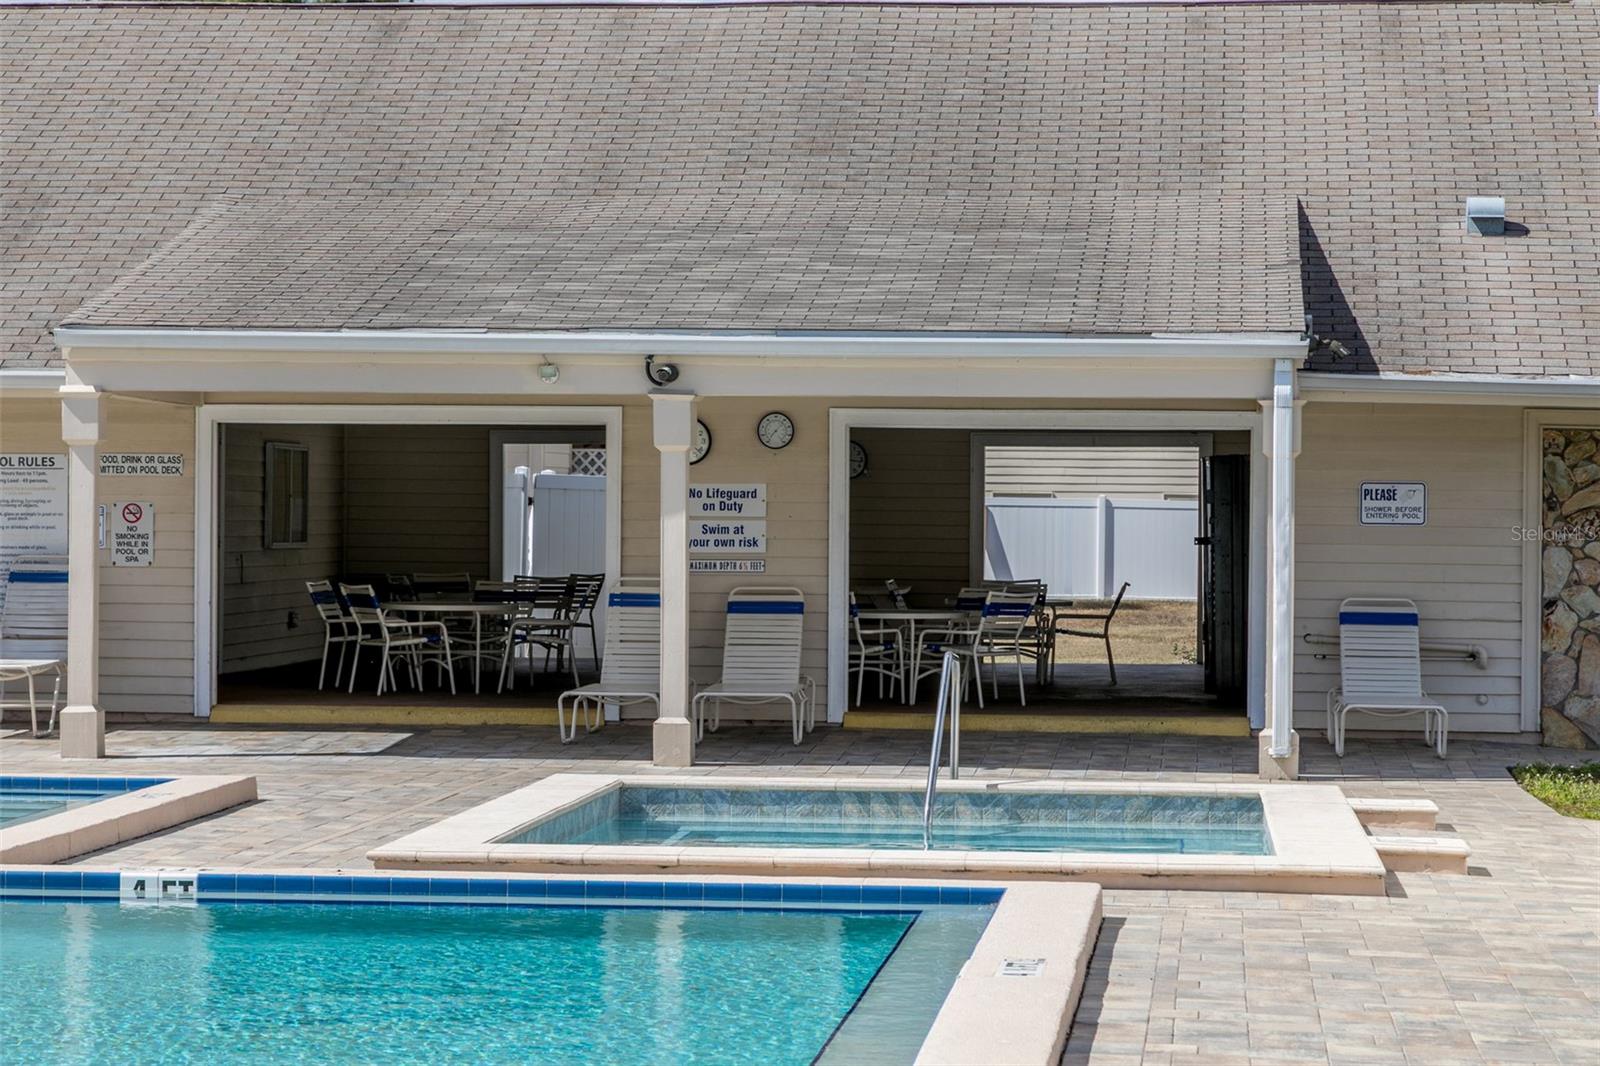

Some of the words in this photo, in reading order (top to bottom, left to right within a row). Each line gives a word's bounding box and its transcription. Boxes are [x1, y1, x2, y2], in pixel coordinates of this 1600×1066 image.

[18, 456, 56, 467] RULES
[121, 455, 142, 464] DRINK
[144, 455, 155, 464] OR
[157, 455, 181, 464] GLASS
[127, 465, 138, 474] ON
[140, 465, 159, 474] POOL
[689, 488, 702, 499] No
[706, 488, 757, 501] Lifeguard
[1364, 488, 1398, 501] PLEASE
[702, 502, 715, 511] on
[719, 501, 743, 513] Duty
[702, 524, 730, 535] Swim
[733, 525, 744, 535] at
[714, 539, 735, 547] own
[739, 537, 759, 548] risk
[689, 561, 717, 570] MAXIMUM
[719, 561, 737, 570] DEPTH
[750, 561, 762, 570] FEET
